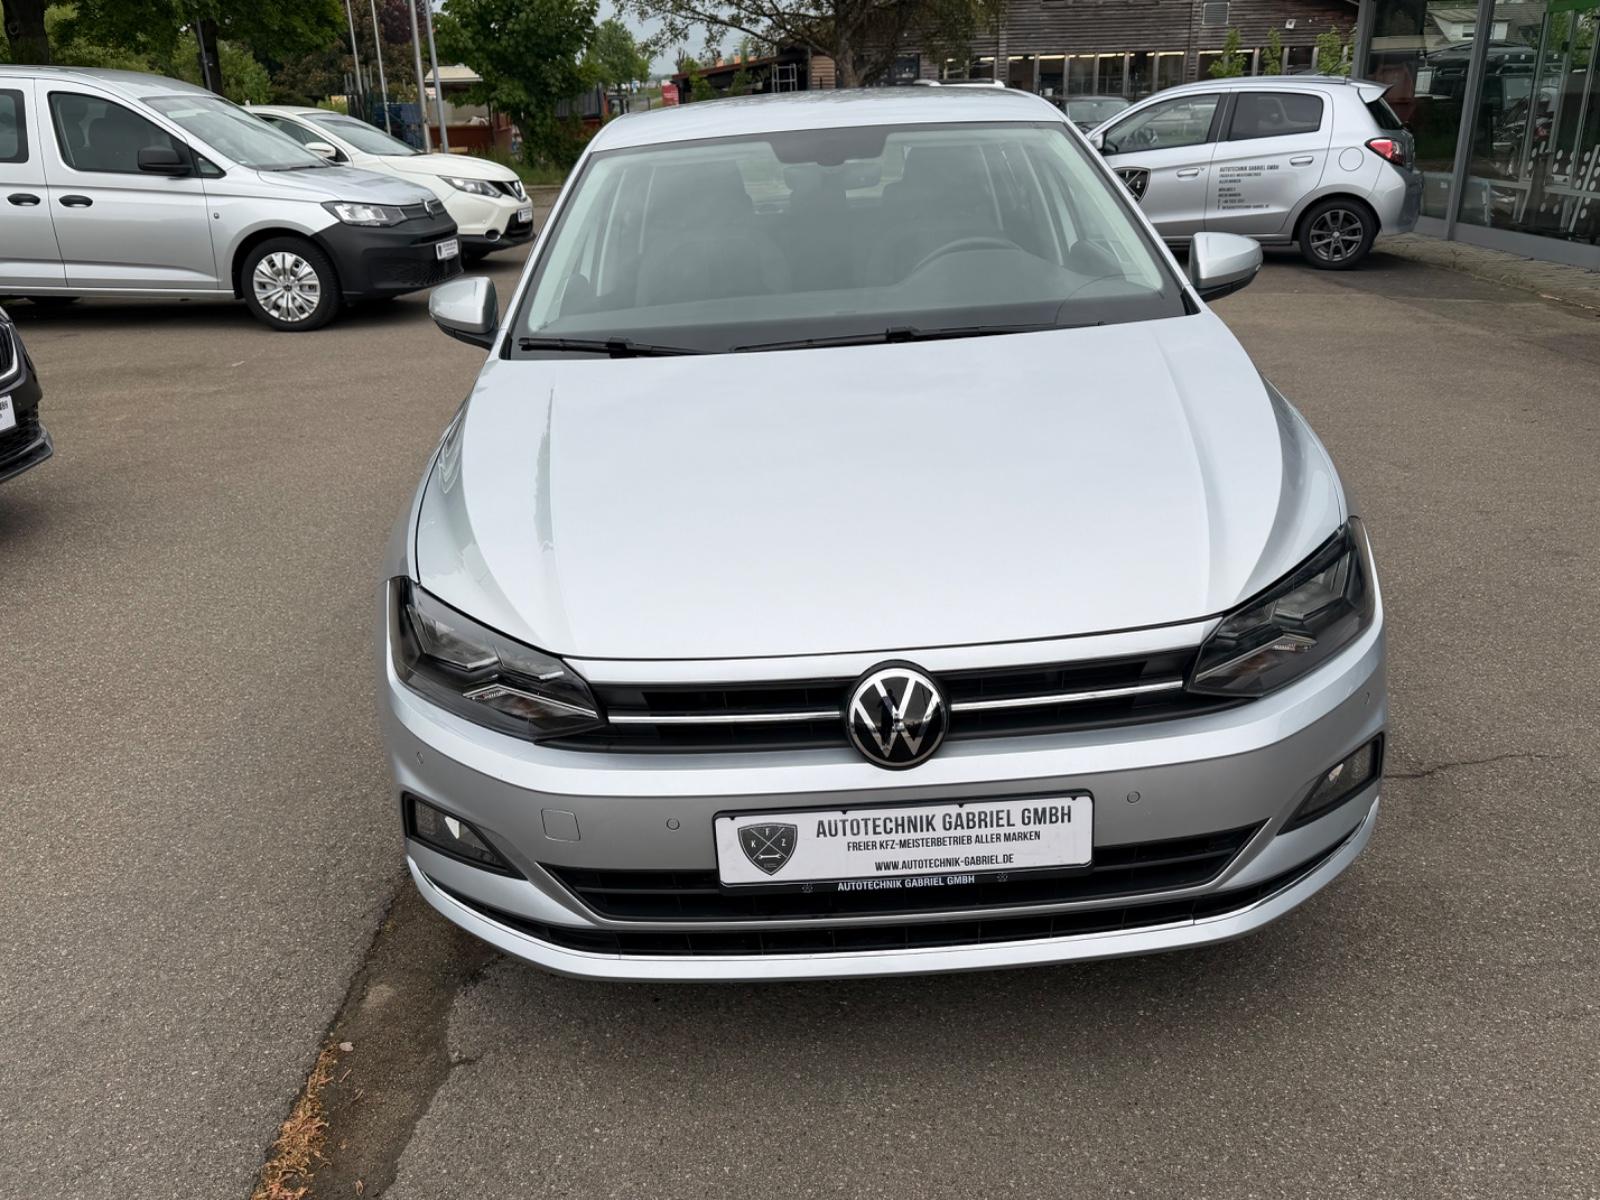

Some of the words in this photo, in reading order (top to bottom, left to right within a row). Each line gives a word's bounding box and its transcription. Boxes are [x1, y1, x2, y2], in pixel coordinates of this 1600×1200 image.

[816, 814, 937, 838] AUTOTECHNIK
[942, 809, 1016, 832] GABRIEL
[1021, 805, 1072, 826] GMBH
[751, 840, 757, 848] K
[847, 840, 877, 852] FREIER
[879, 835, 973, 850] KFZ-MEISTERBETRIEB
[974, 831, 1002, 845] ALLER
[1003, 830, 1041, 843] MARKEN
[875, 853, 1014, 872] WWW.AUTOTECHNIK-GABRIEL.DE
[837, 880, 902, 892] AUTOTECHNIK
[904, 877, 945, 888] GABRIEL
[947, 875, 975, 886] GMBH
